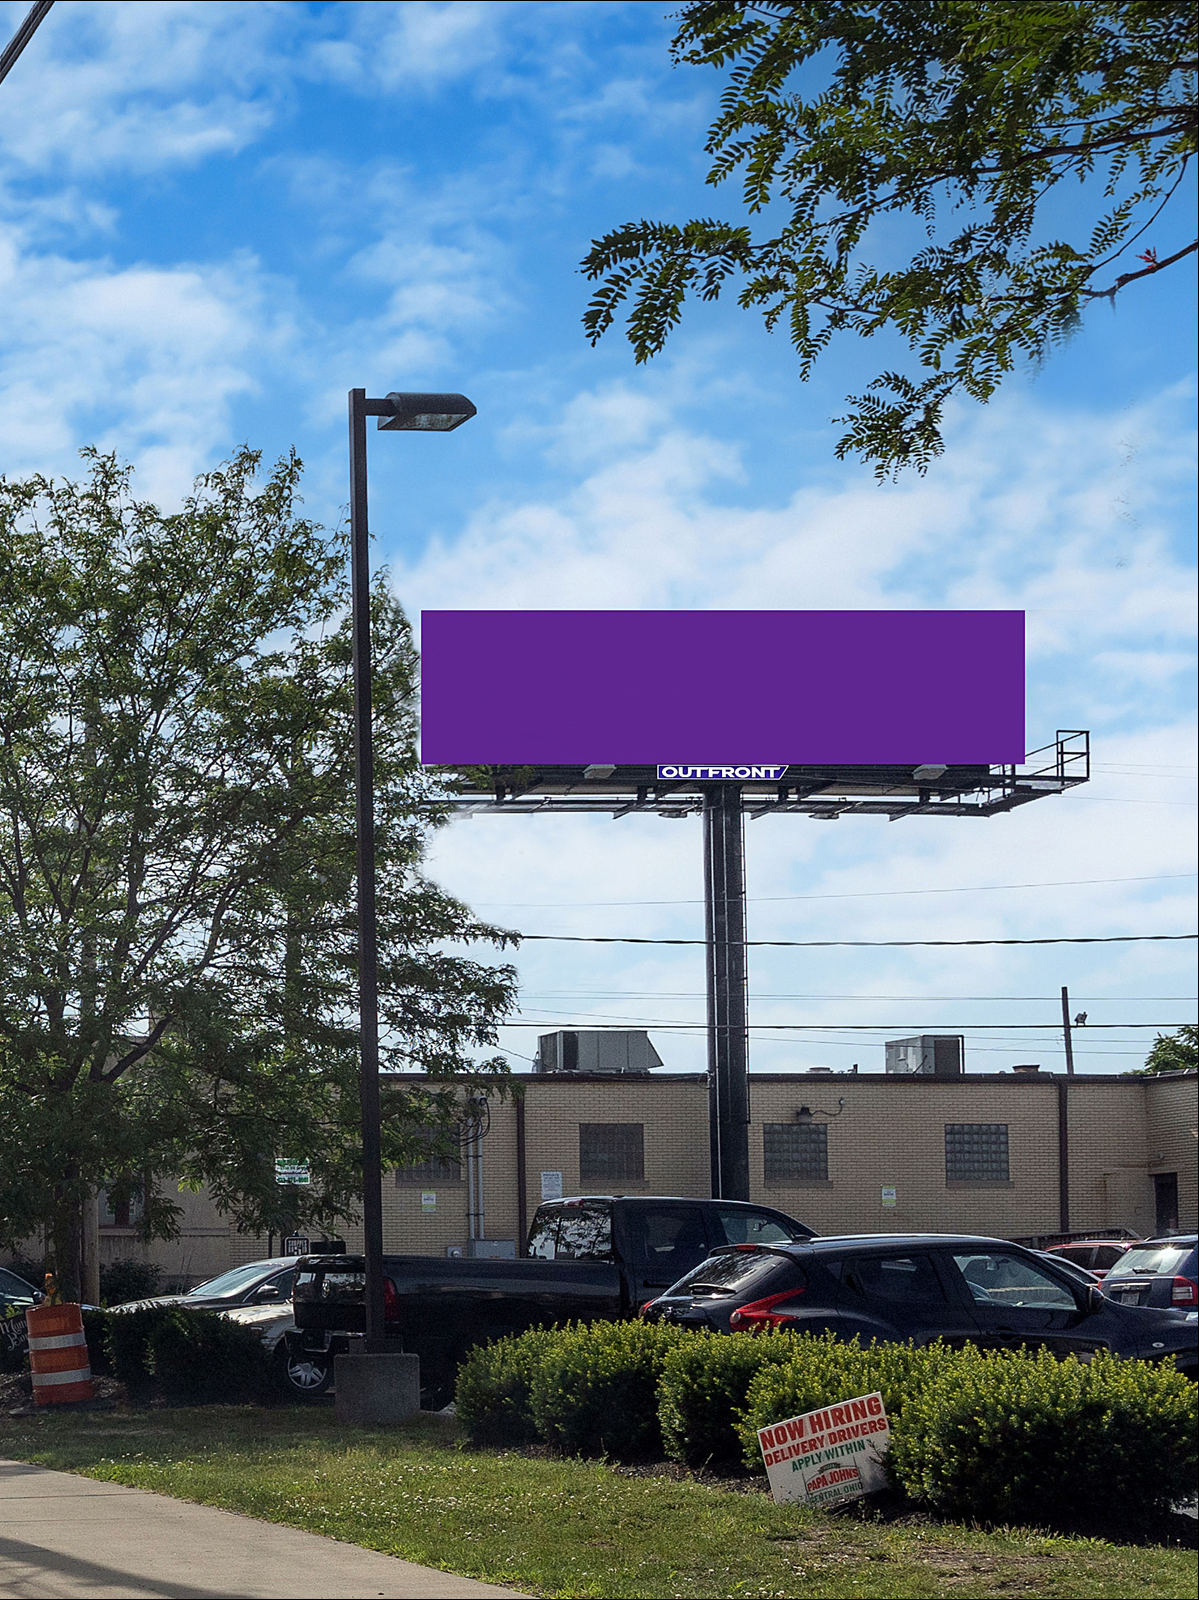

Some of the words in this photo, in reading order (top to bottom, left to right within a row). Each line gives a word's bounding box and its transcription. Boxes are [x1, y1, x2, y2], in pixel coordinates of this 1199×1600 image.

[661, 766, 780, 779] OUTFRONT
[759, 1419, 804, 1451] NOW
[809, 1396, 882, 1434] HIRING
[764, 1435, 825, 1467] DELIVERY
[828, 1418, 887, 1445] DRIVERS
[792, 1451, 822, 1472] APPLY
[825, 1439, 866, 1461] WITHIN
[807, 1474, 828, 1491] PAPA
[810, 1488, 842, 1504] CENTRAL
[844, 1481, 863, 1494] OHIO
